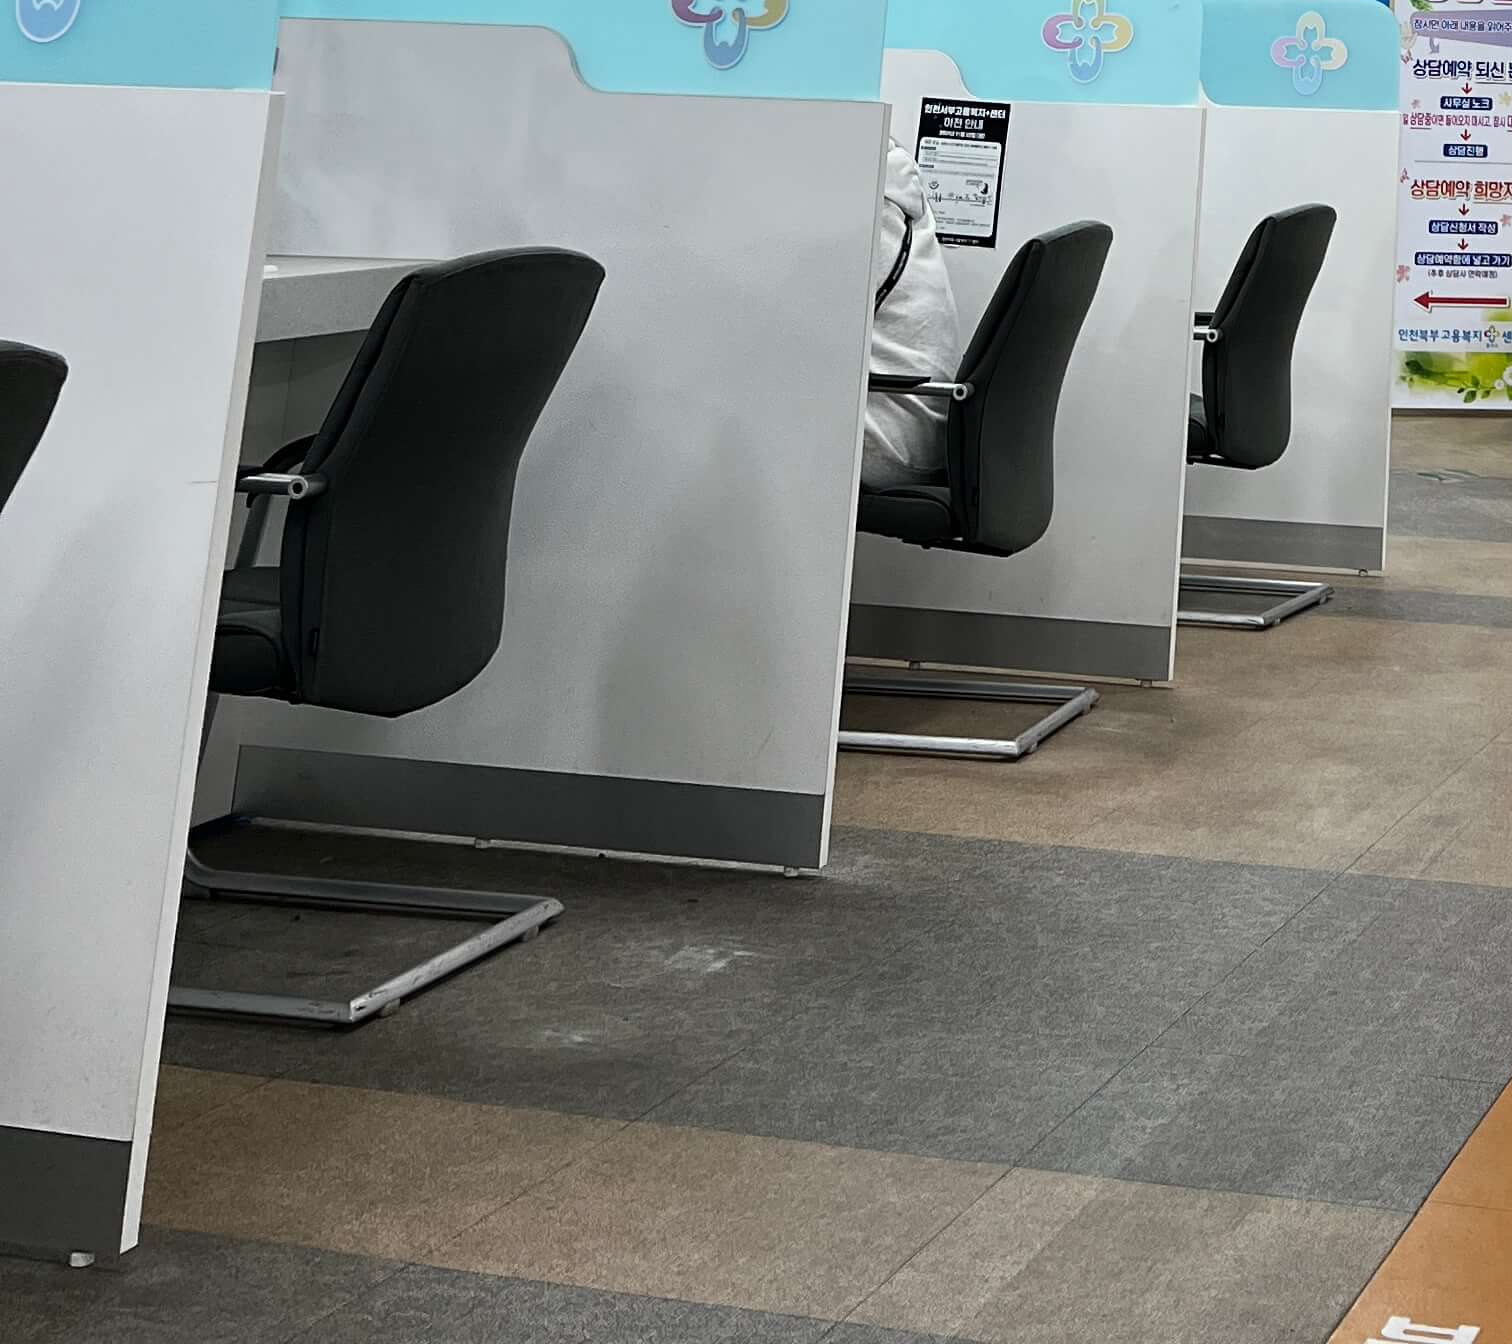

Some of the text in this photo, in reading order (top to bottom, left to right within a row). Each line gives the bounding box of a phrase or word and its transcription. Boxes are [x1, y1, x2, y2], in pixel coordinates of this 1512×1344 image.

[1441, 19, 1458, 31] 아래
[1413, 59, 1473, 78] 상담예약
[1475, 61, 1504, 79] 되신
[1443, 98, 1490, 109] 사무실 노크
[1448, 145, 1484, 157] 상담진행
[1411, 179, 1470, 198] 상담예약
